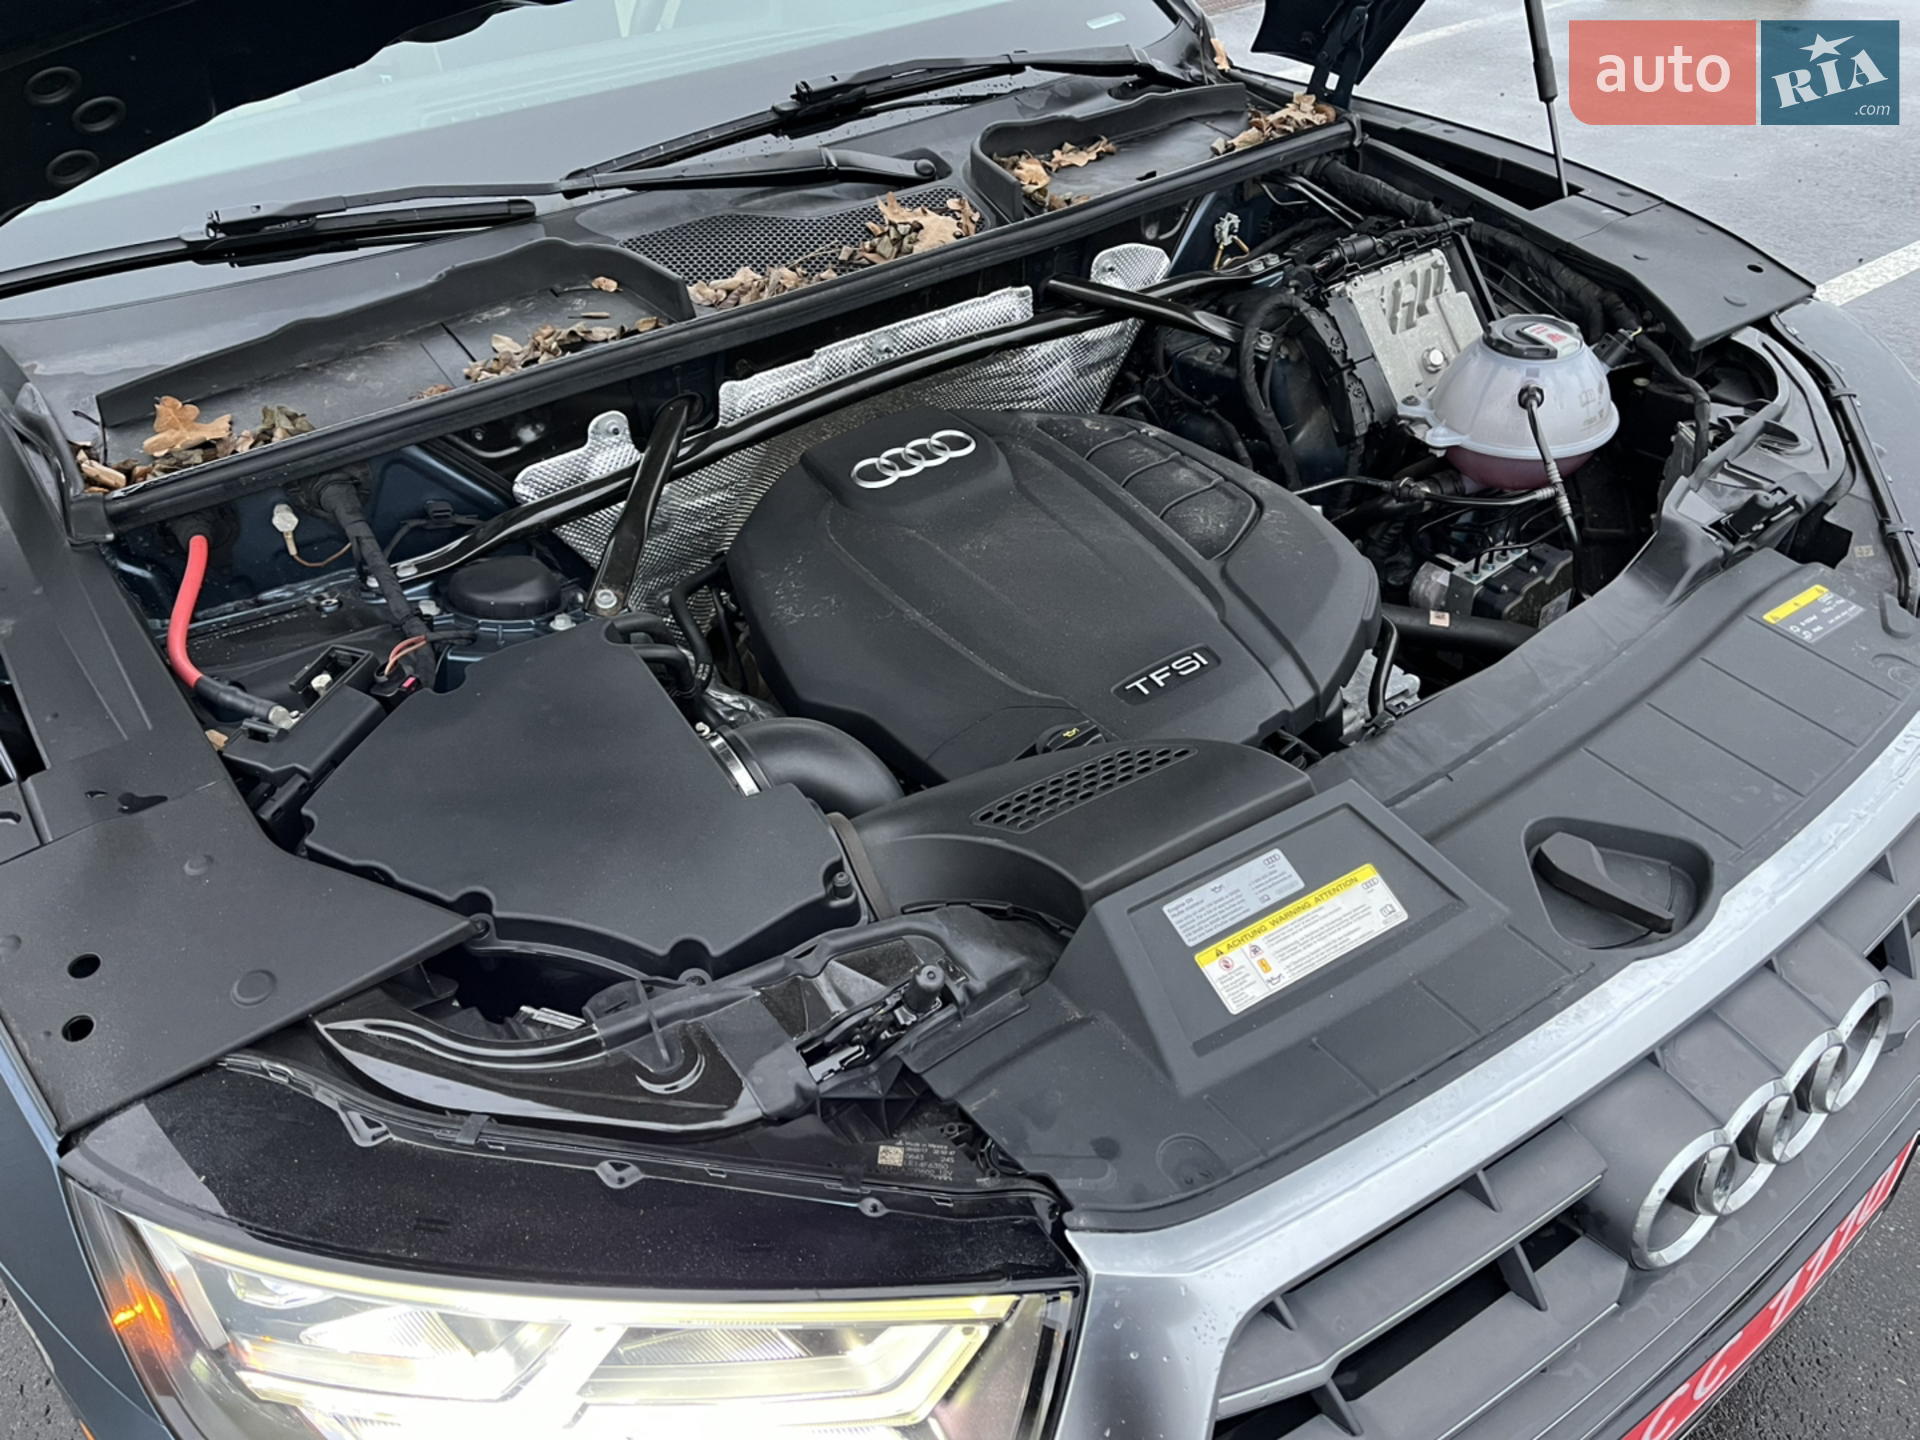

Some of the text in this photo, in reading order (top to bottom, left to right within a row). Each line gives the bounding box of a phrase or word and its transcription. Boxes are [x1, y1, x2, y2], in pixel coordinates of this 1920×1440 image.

[1125, 652, 1209, 695] TFSI
[1226, 924, 1268, 951] ACHTUNG
[1269, 901, 1312, 927] WARNING
[1314, 876, 1359, 905] ATTENTION
